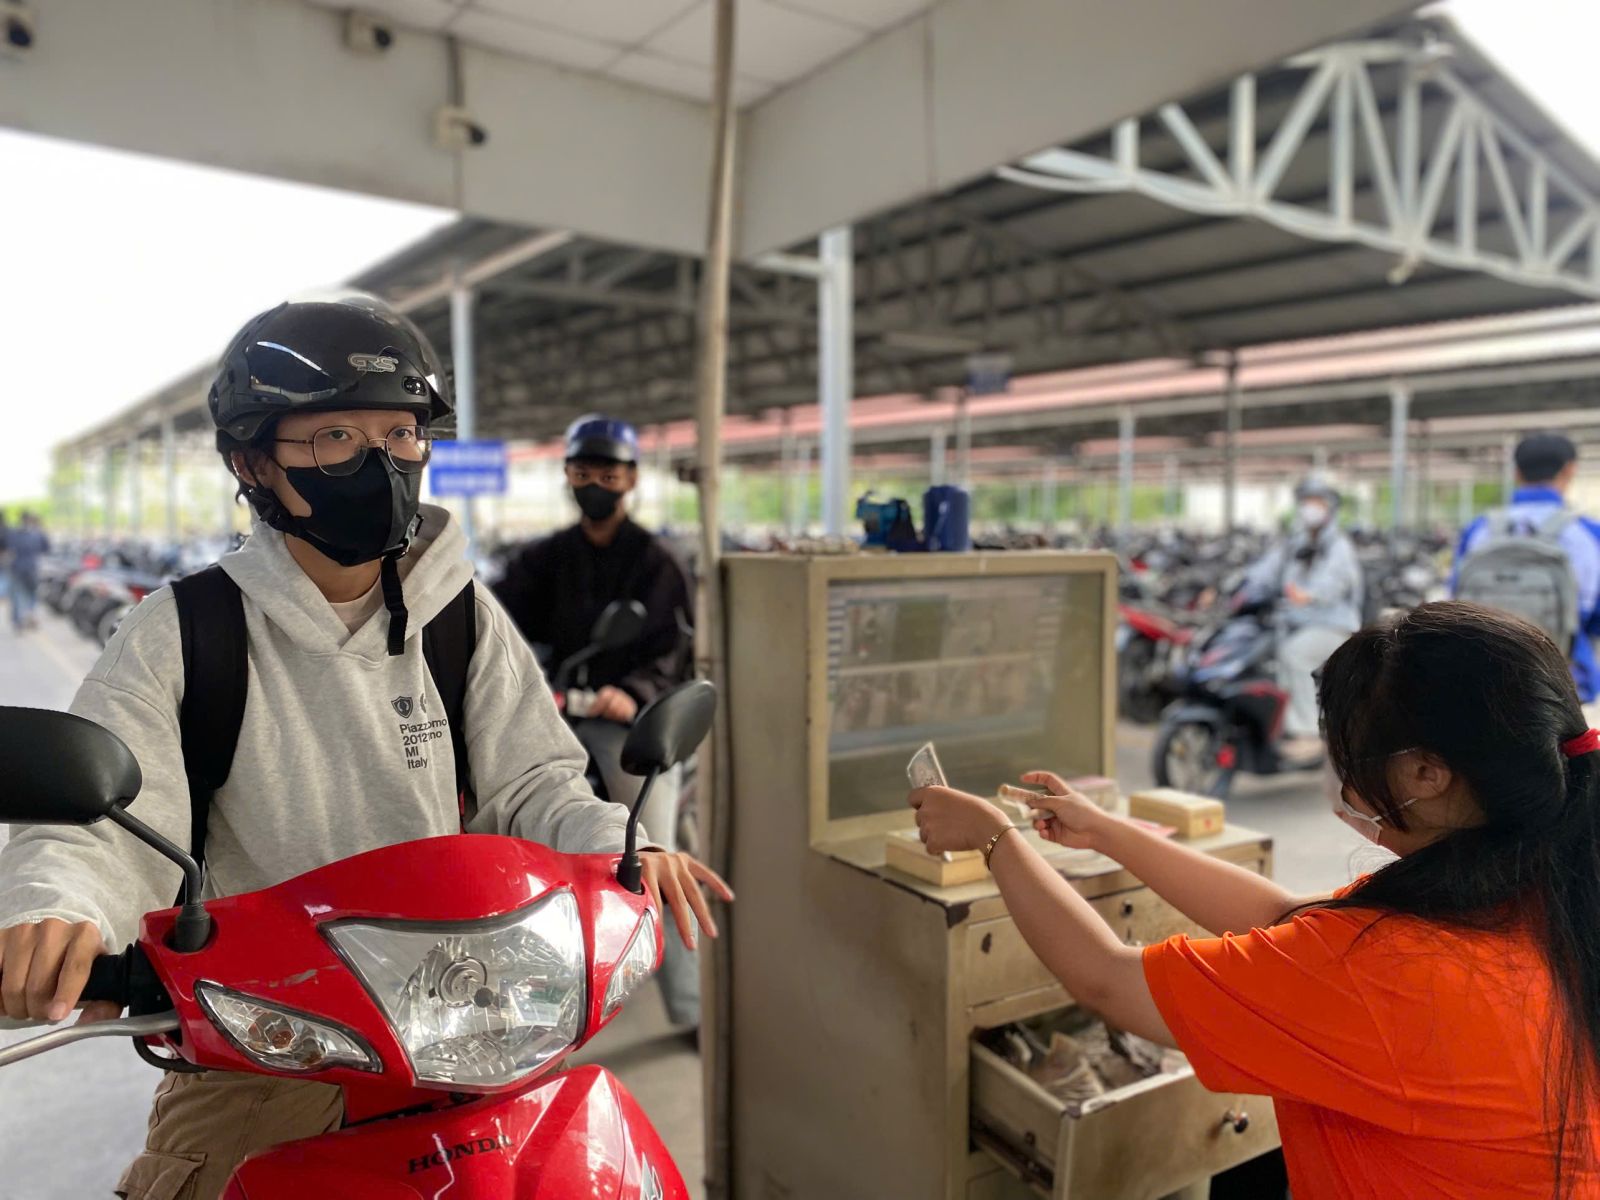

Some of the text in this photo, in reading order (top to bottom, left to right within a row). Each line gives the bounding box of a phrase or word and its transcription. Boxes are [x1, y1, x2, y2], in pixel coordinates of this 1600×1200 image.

[405, 746, 419, 758] MI
[407, 757, 428, 769] Italy
[408, 1134, 513, 1174] HONDA
